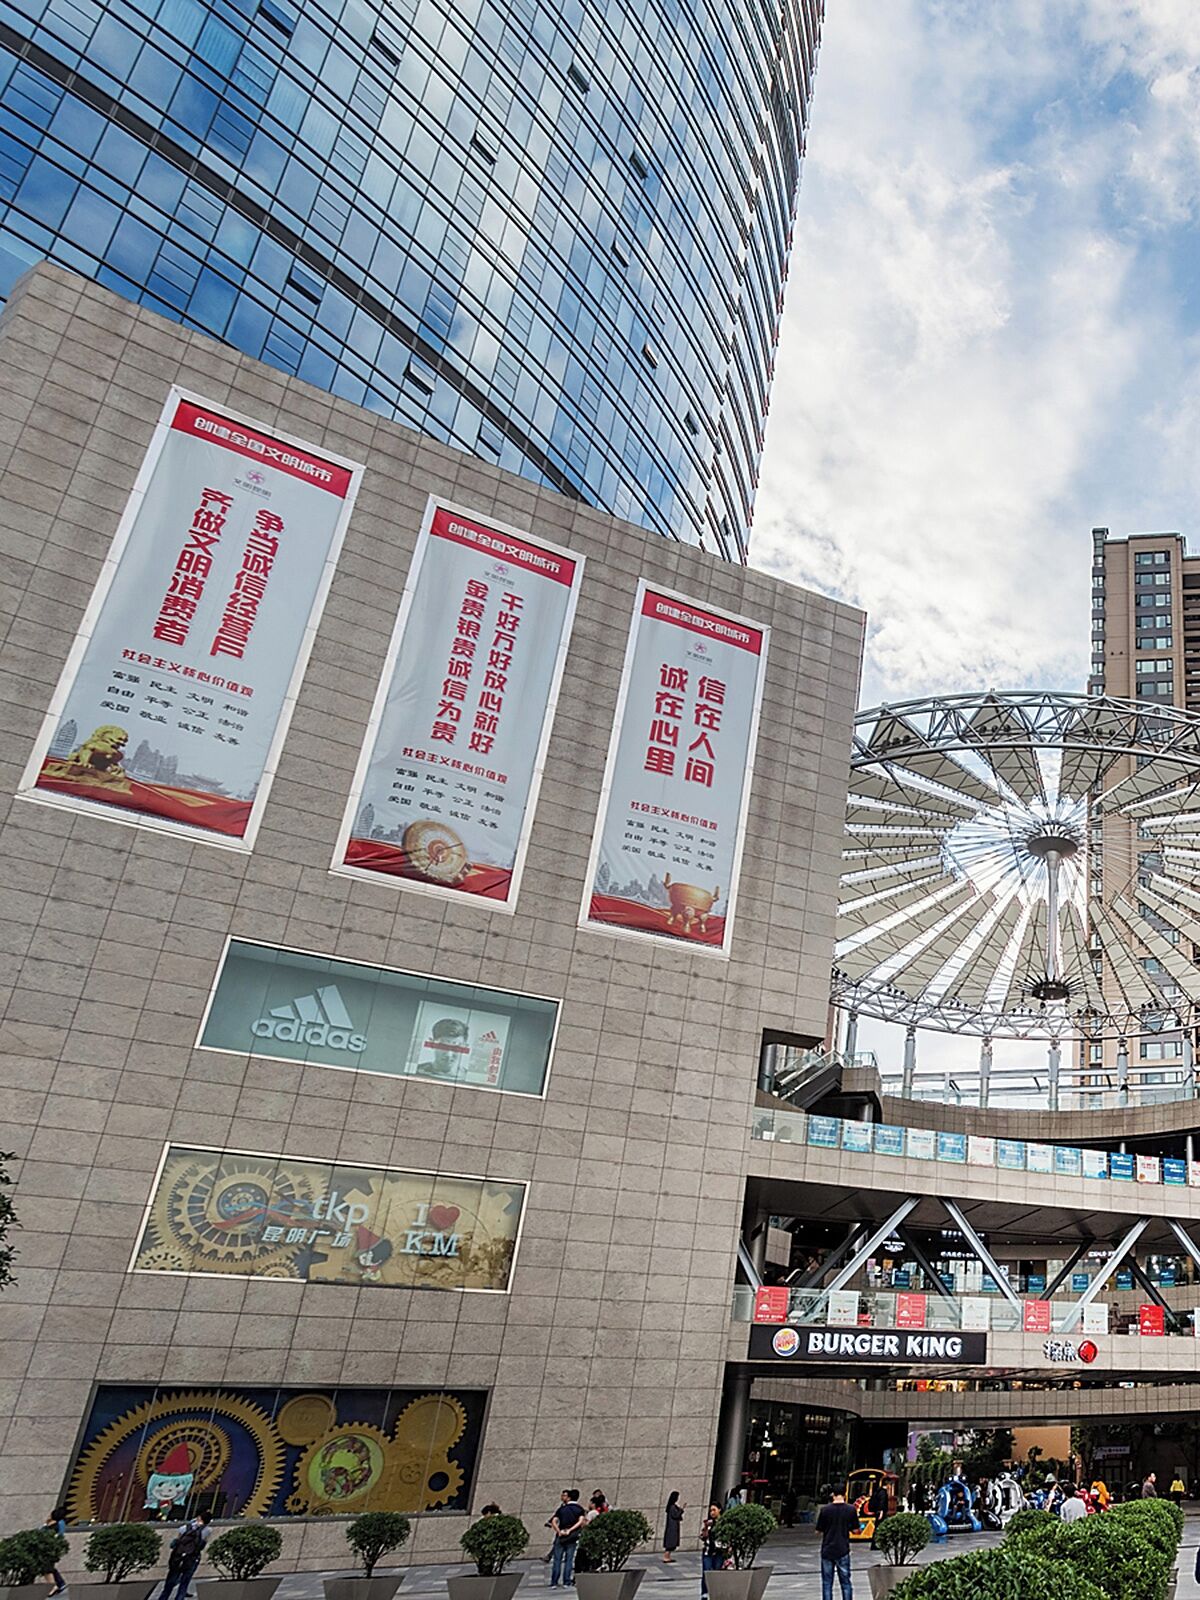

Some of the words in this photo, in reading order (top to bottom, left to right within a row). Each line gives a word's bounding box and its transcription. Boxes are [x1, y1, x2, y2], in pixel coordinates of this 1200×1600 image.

[194, 416, 332, 483] 创建全国文明城市
[151, 487, 235, 647] 齐做文明消费者
[447, 521, 561, 574] 创建全国文明城市
[210, 509, 285, 659] 争当诚信经营户
[655, 601, 751, 644] 创建全国文明城市
[121, 649, 254, 697] 社会主义核心价值观
[430, 577, 490, 746] 金贵银贵诚信为贵
[468, 591, 525, 756] 千好万好放心就好
[644, 663, 688, 776] 诚在心里
[683, 675, 727, 789] 信在人间
[402, 747, 508, 784] 社会主义核心价值观
[251, 1019, 367, 1052] adidas
[261, 1225, 353, 1248] 昆明广场
[312, 1192, 369, 1231] tkp
[400, 1230, 463, 1257] KM
[808, 1332, 900, 1357] BURGER
[906, 1335, 962, 1358] KING
